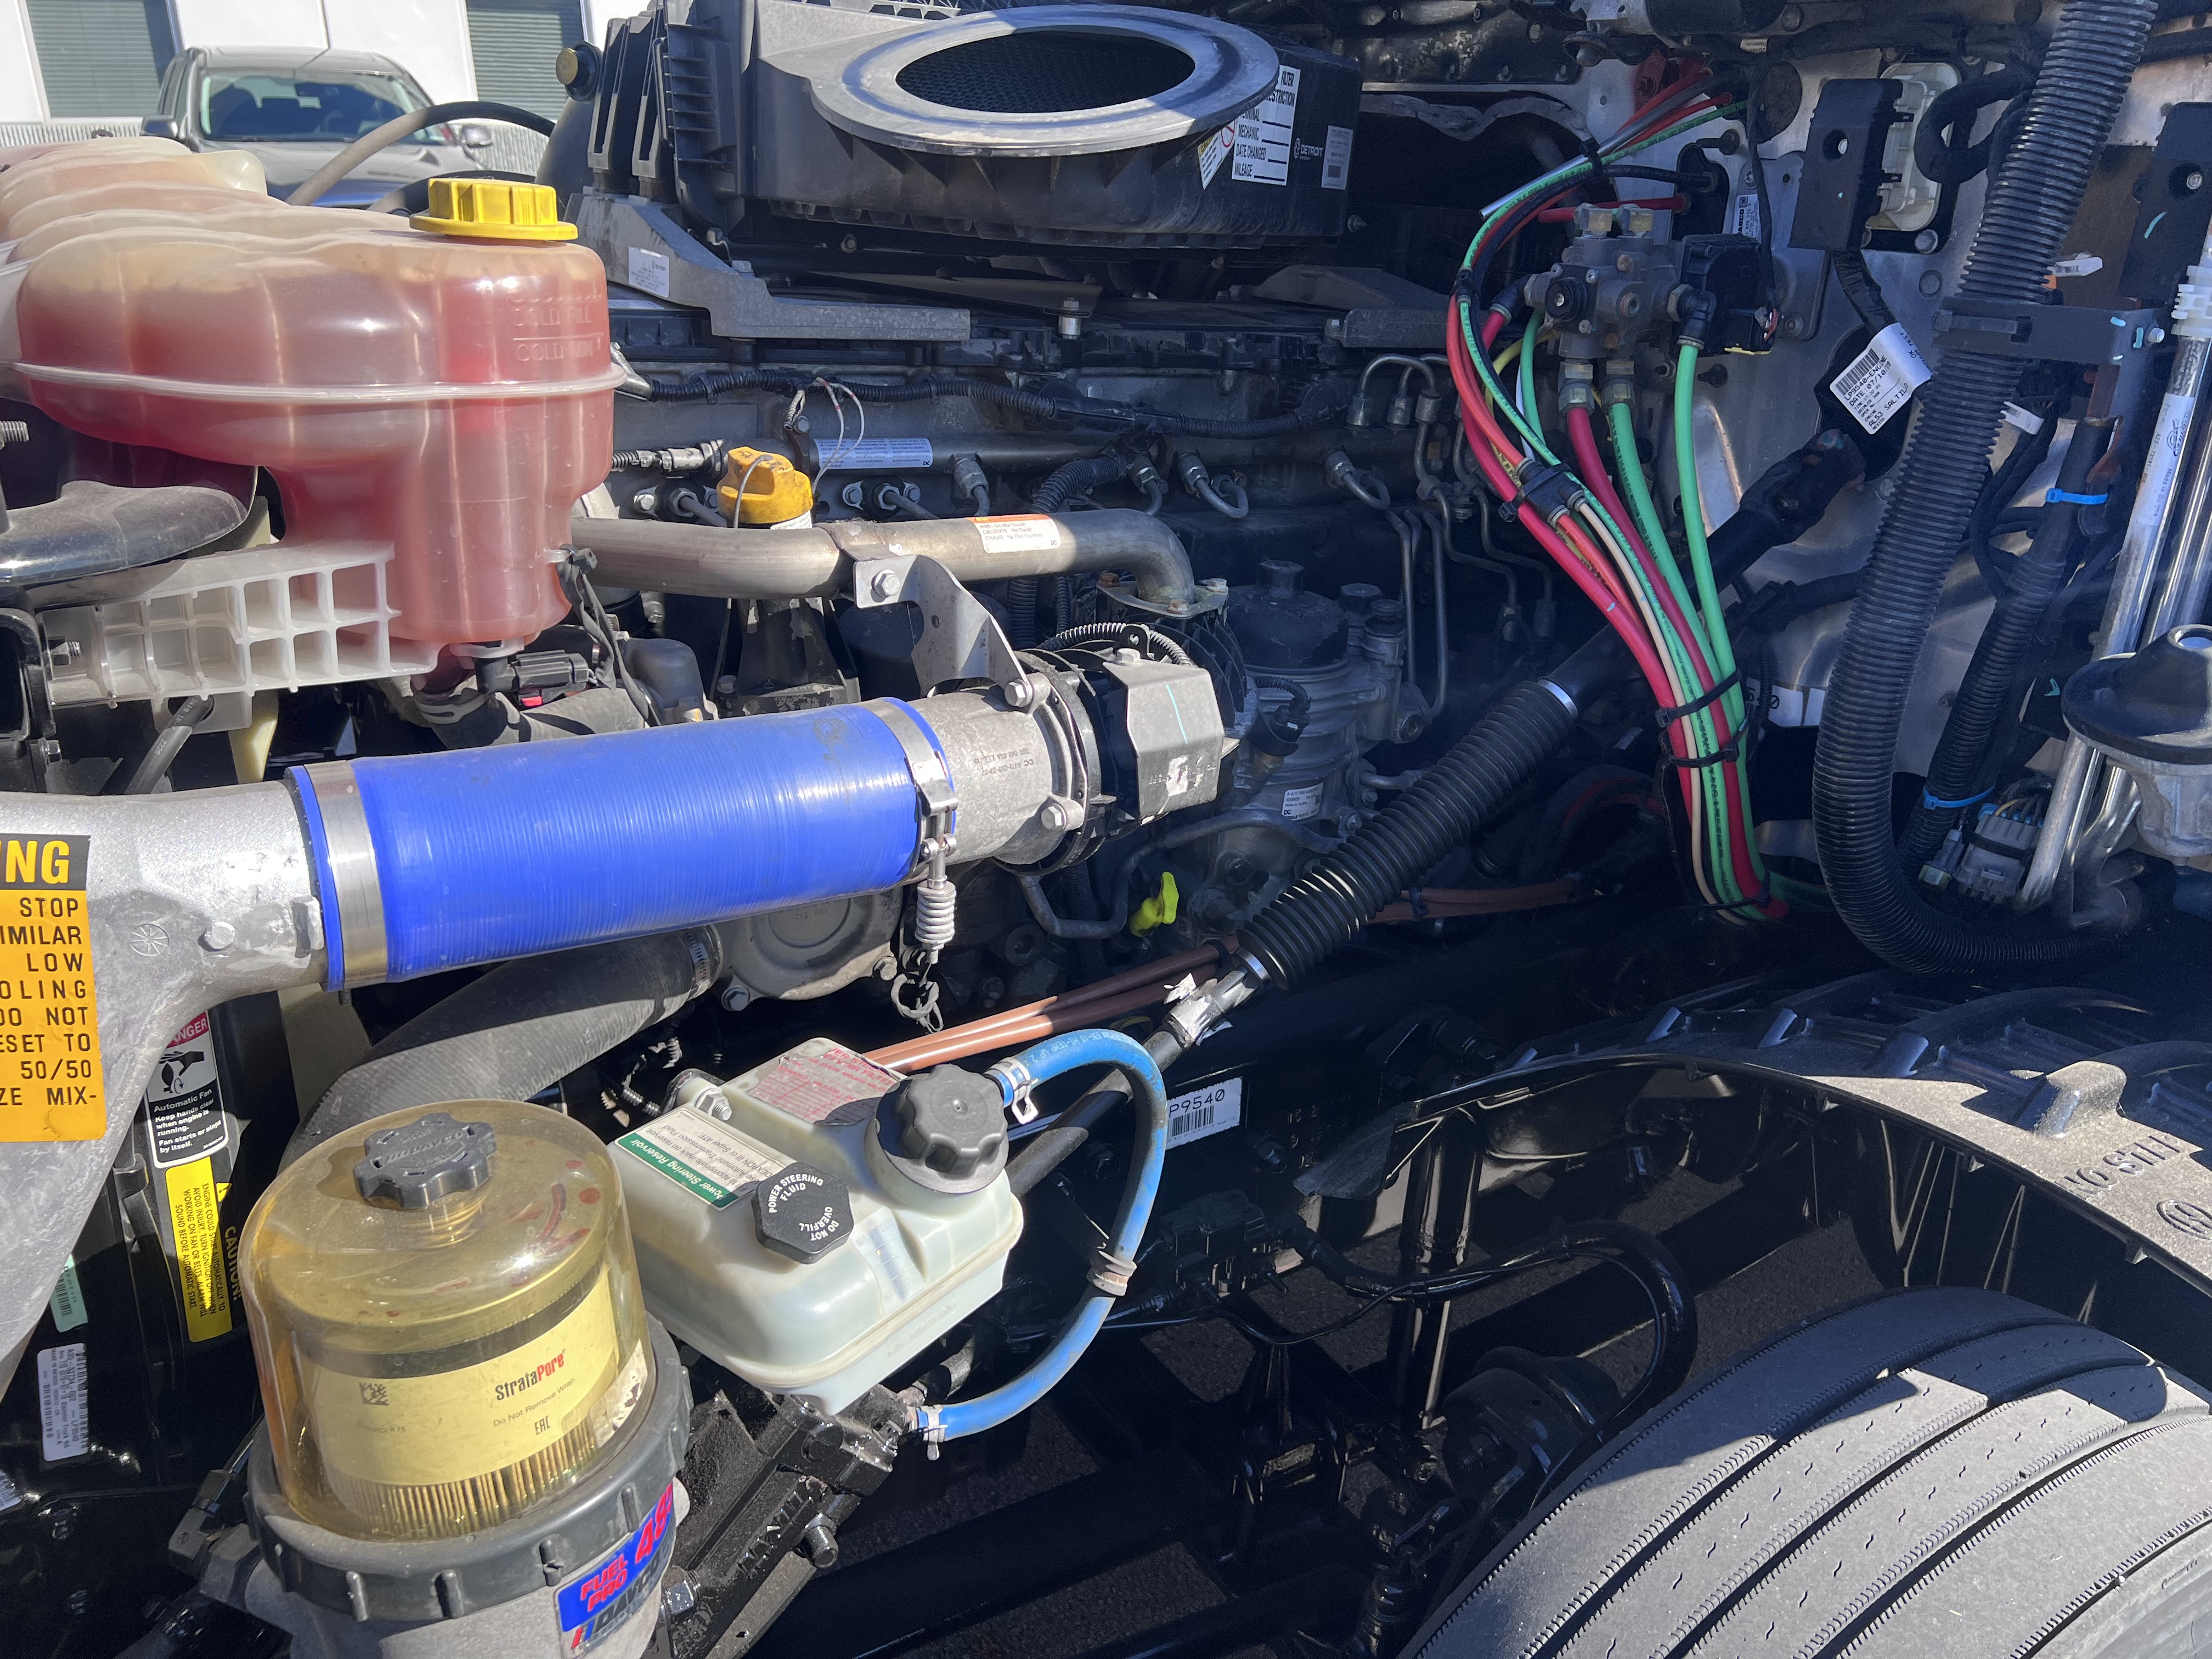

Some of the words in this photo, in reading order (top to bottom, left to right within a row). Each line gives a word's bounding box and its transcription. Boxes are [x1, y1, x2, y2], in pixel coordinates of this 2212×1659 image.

[1266, 89, 1295, 107] ESTRICTION
[1238, 124, 1259, 141] MECHANIC
[1236, 143, 1247, 157] DATE
[1247, 144, 1266, 160] CHANGED
[1300, 144, 1323, 157] DETROIT
[1234, 162, 1253, 177] MILEAGE
[513, 308, 561, 326] COLD
[517, 343, 564, 362] COLD
[1906, 348, 1918, 360] OK
[1844, 354, 1888, 402] LP9540-ENGINE
[1868, 410, 1884, 428] AL53
[1883, 382, 1910, 411] SALTILLO
[2162, 468, 2172, 485] Made
[0, 840, 70, 884] NG
[20, 897, 78, 917] STOP
[0, 926, 82, 945] IMILAR
[26, 953, 83, 972] LOW
[0, 980, 86, 1000] OLING
[46, 1006, 88, 1025] NOT
[64, 1032, 91, 1052] TO
[21, 1059, 92, 1080] 50/50
[47, 1086, 97, 1105] MIX-
[154, 1093, 198, 1113] Automatic
[199, 1088, 212, 1099] Fan
[155, 1113, 176, 1123] Keep
[176, 1107, 199, 1118] hands
[200, 1098, 214, 1109] clear
[156, 1121, 177, 1130] when
[178, 1113, 202, 1125] engine
[662, 1125, 678, 1136] Fluid
[157, 1126, 189, 1137] running.
[159, 1138, 173, 1147] Fan
[174, 1131, 196, 1142] starts
[206, 1119, 222, 1133] stops
[646, 1127, 672, 1146] reservoir.
[697, 1132, 713, 1142] ATF.
[160, 1146, 170, 1154] by
[171, 1141, 193, 1152] itself.
[630, 1138, 669, 1165] Reservoir
[678, 1134, 717, 1159] Transmission
[681, 1148, 697, 1160] mark
[713, 1141, 731, 1153] Super
[666, 1160, 702, 1185] Steering
[696, 1158, 731, 1181] appropriate
[716, 1156, 747, 1176] Automatic
[742, 1159, 773, 1178] DEXRON
[193, 1187, 201, 1207] AVOID
[202, 1183, 212, 1209] ENGINE
[699, 1181, 724, 1200] Power
[768, 1184, 783, 1214] POWER
[780, 1173, 824, 1186] STEERING
[780, 1182, 806, 1201] FLUID
[183, 1189, 194, 1222] WORKING
[175, 1204, 185, 1228] SOUND
[195, 1209, 205, 1233] INJURY,
[205, 1209, 215, 1231] COULD
[799, 1206, 833, 1232] OVERFILL
[188, 1223, 196, 1234] ON
[810, 1229, 828, 1242] NOT
[827, 1220, 839, 1232] DO
[179, 1229, 188, 1252] BEFORE
[190, 1235, 198, 1249] FAN
[199, 1233, 208, 1251] TURN
[209, 1232, 218, 1250] START
[191, 1250, 199, 1260] OR
[182, 1254, 194, 1290] AUTOMATIC
[202, 1252, 212, 1281] IGNITION
[187, 1291, 196, 1310] START.
[196, 1281, 205, 1302] ALARM
[199, 1303, 207, 1317] WILL
[218, 1302, 225, 1311] TO
[493, 1419, 506, 1427] Do
[508, 1409, 523, 1421] Not
[525, 1391, 556, 1413] Remove
[556, 1378, 576, 1394] Wrap.
[580, 1553, 628, 1601] FUEL
[587, 1568, 628, 1612] PRO
